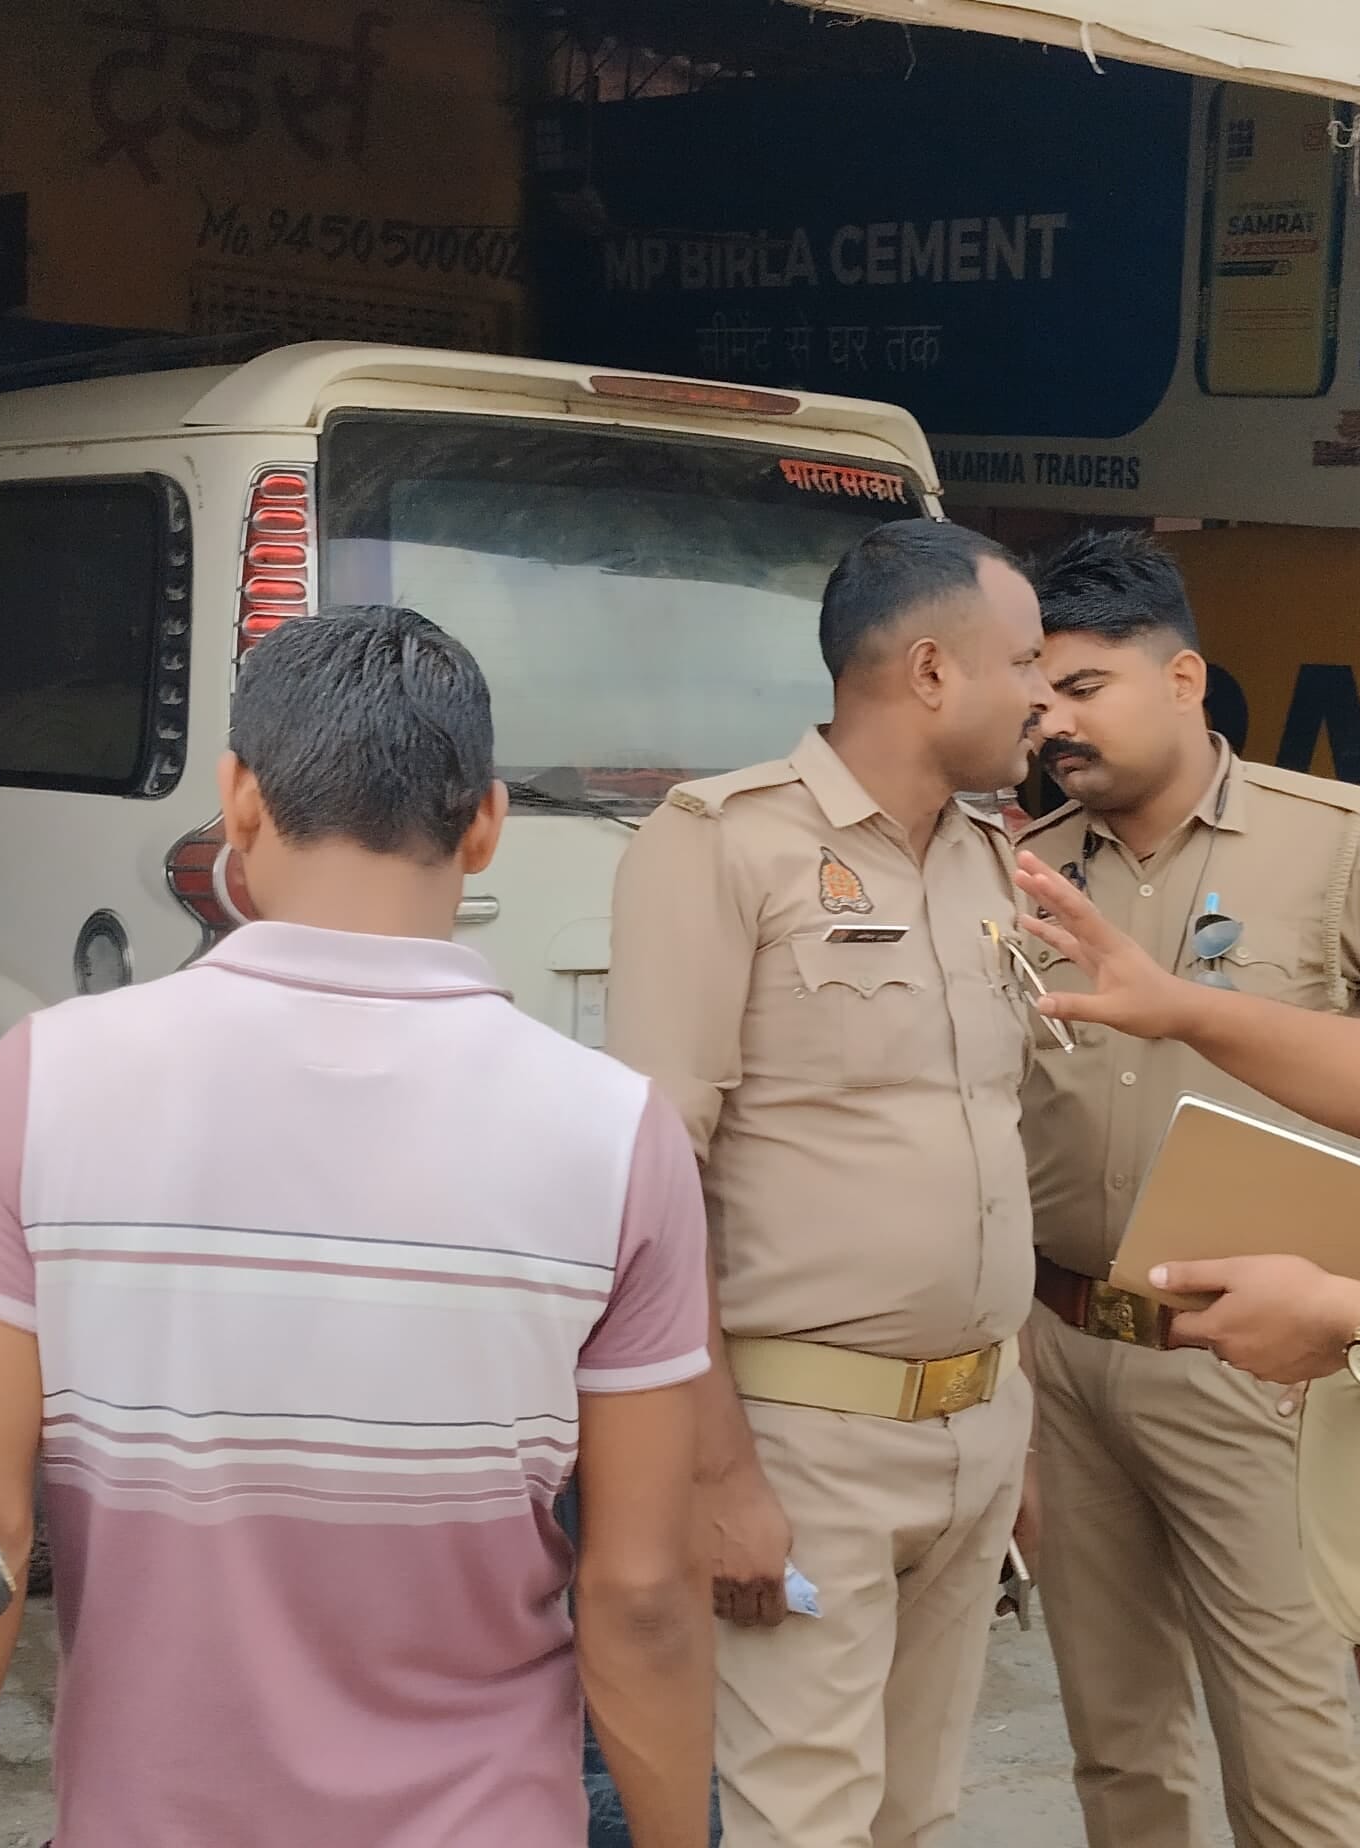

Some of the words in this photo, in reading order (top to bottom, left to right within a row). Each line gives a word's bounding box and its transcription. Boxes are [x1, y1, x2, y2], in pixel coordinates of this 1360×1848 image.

[1227, 212, 1318, 236] SAMRAT
[604, 237, 671, 291] MP
[680, 228, 820, 289] BIRLA
[829, 212, 1072, 285] CEMENT
[783, 306, 815, 369] से
[827, 325, 870, 372] घर
[882, 323, 944, 373] तक
[1034, 453, 1140, 490] TRADERS
